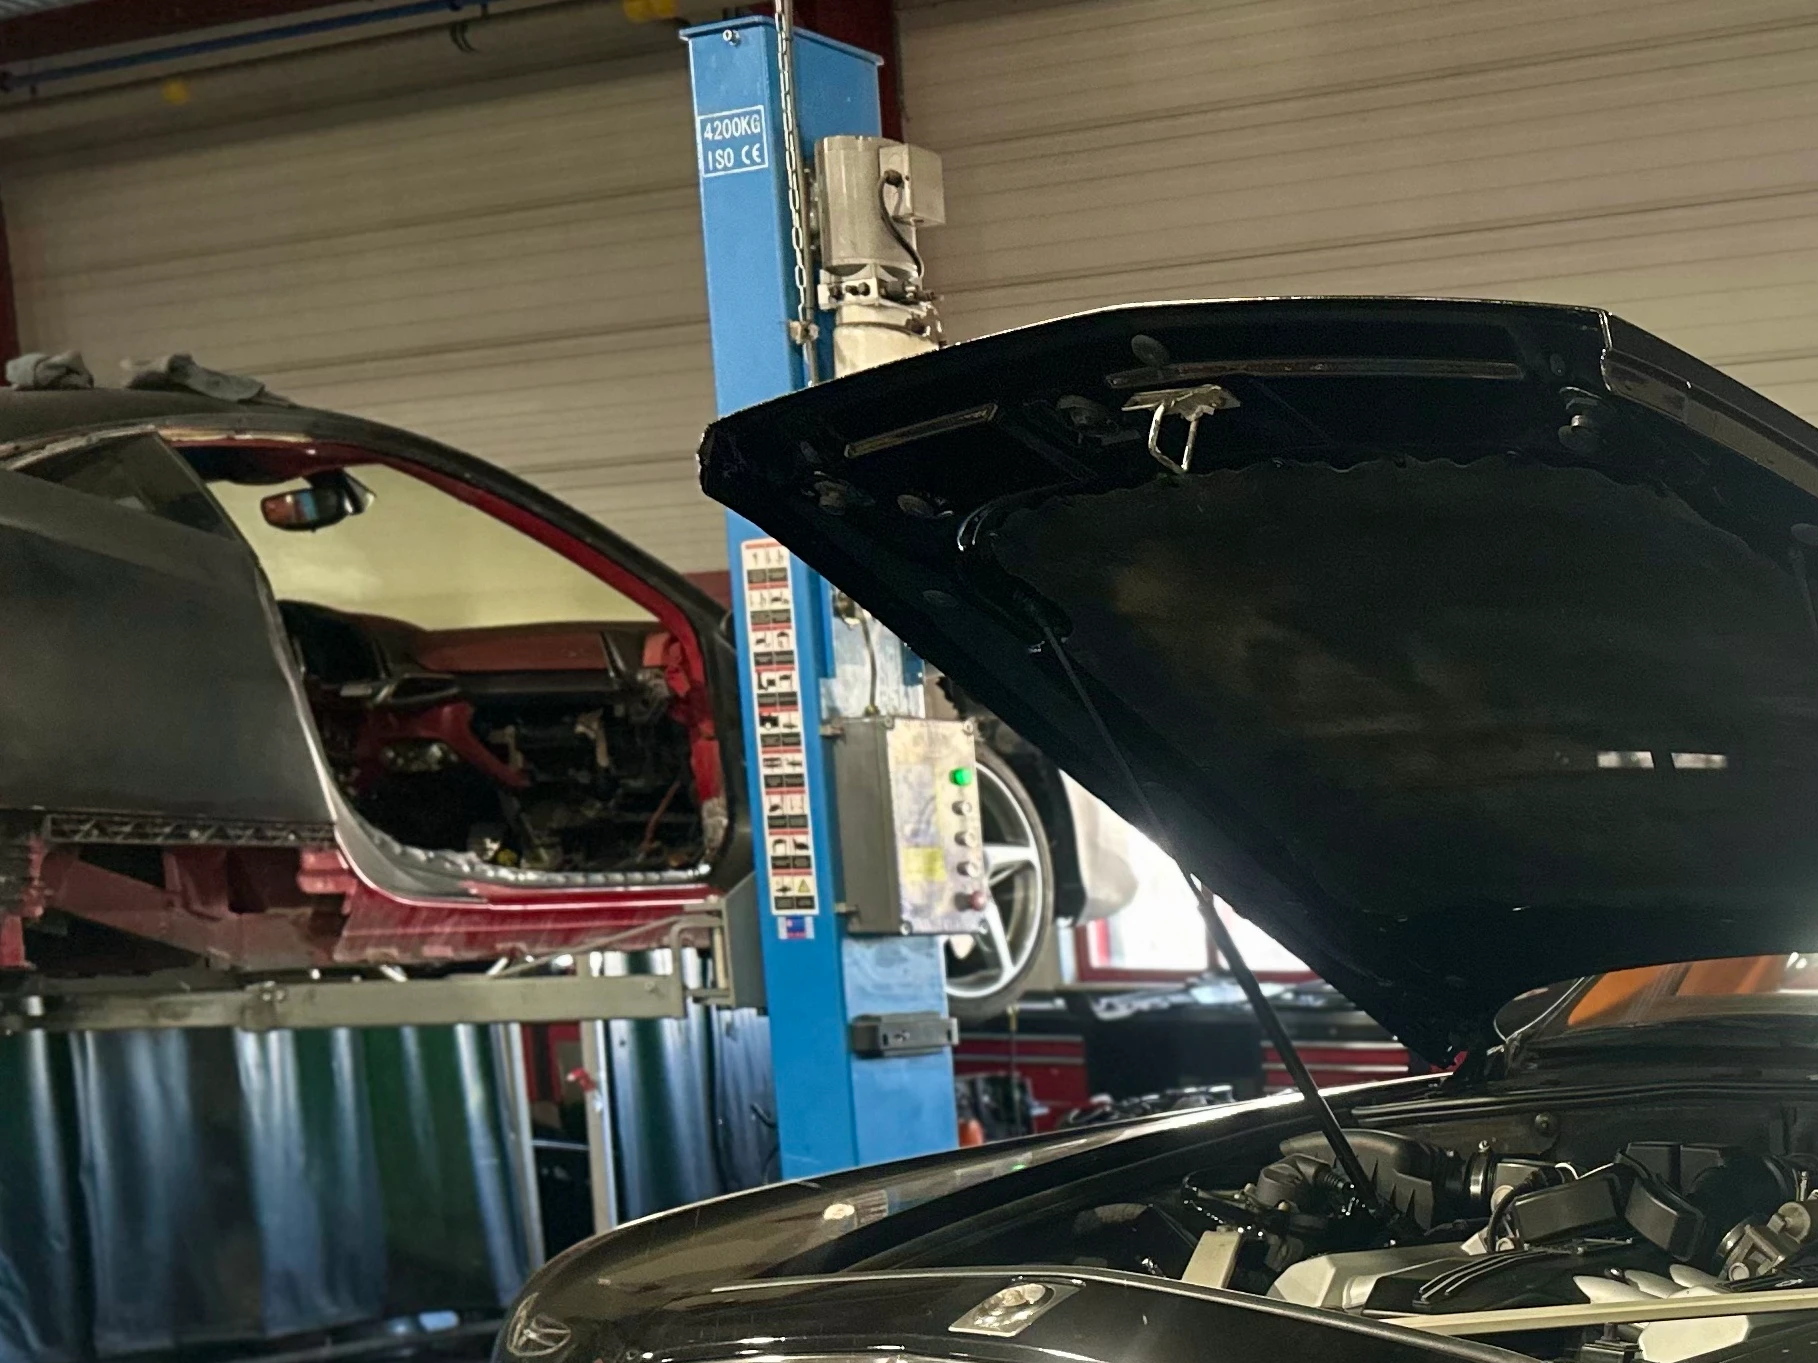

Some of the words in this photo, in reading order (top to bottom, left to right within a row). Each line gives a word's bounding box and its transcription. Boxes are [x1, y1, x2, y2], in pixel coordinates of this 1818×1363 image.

[703, 113, 761, 141] 4200KG
[708, 147, 735, 171] ISO
[741, 143, 762, 165] CE
